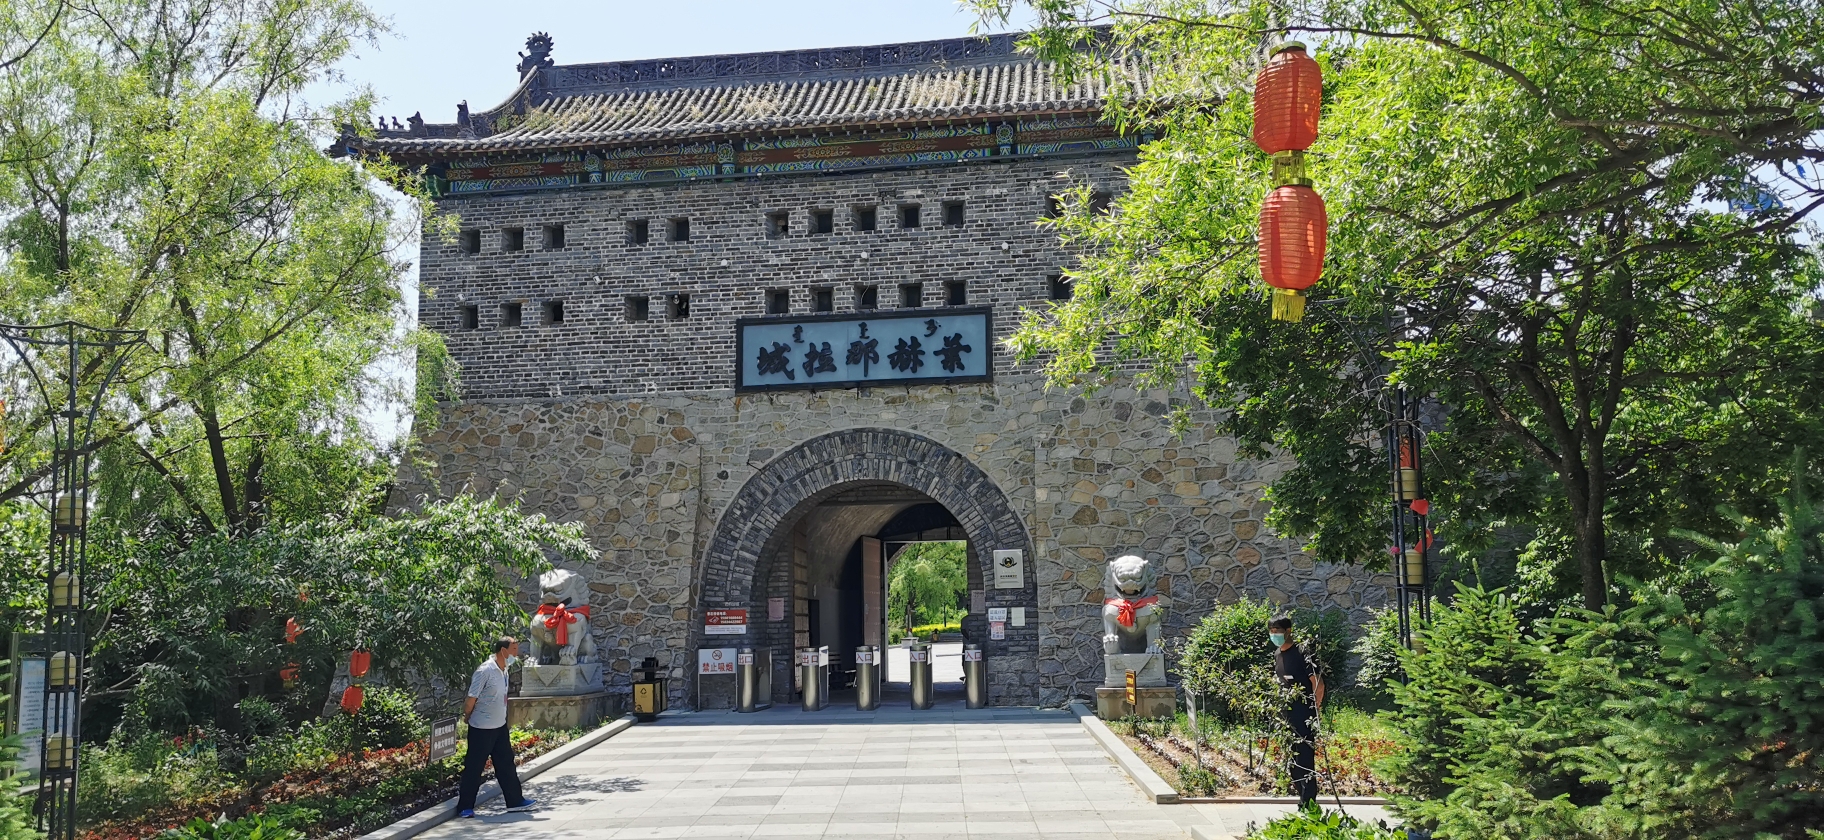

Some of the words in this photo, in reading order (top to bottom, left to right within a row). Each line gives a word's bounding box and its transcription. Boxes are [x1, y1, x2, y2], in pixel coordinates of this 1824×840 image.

[738, 655, 753, 664] 出口
[802, 654, 819, 664] 出口
[856, 652, 872, 662] 入口
[910, 651, 926, 661] 入口
[965, 651, 982, 660] 入口
[702, 662, 734, 673] 禁止吸烟
